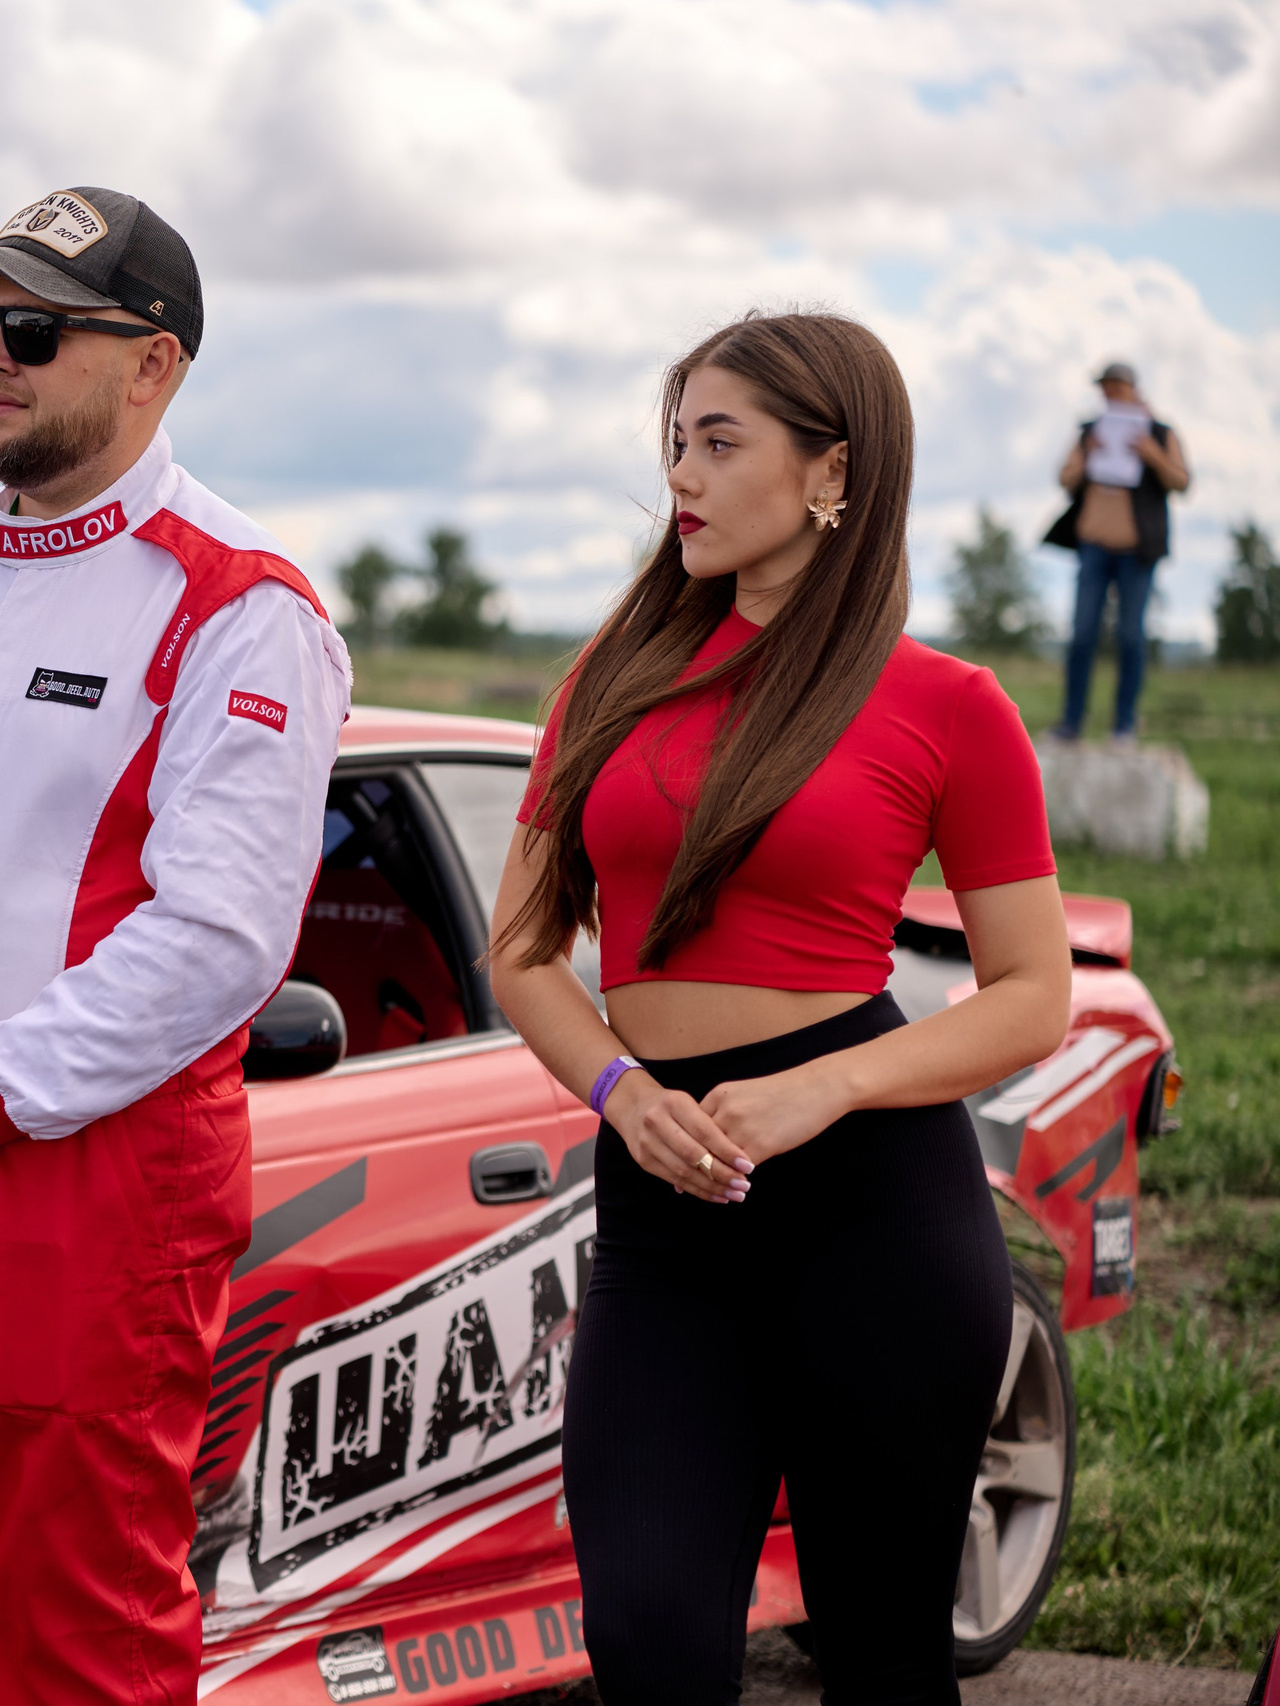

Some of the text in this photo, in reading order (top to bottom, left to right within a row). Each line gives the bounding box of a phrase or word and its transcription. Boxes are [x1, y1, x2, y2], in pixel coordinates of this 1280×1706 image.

[57, 196, 99, 235] KNIGHTS
[53, 227, 84, 244] 2017
[3, 508, 116, 554] A.FROLOV
[161, 613, 191, 668] VOLSON
[232, 697, 285, 722] VOLSON
[305, 901, 406, 926] RIDE
